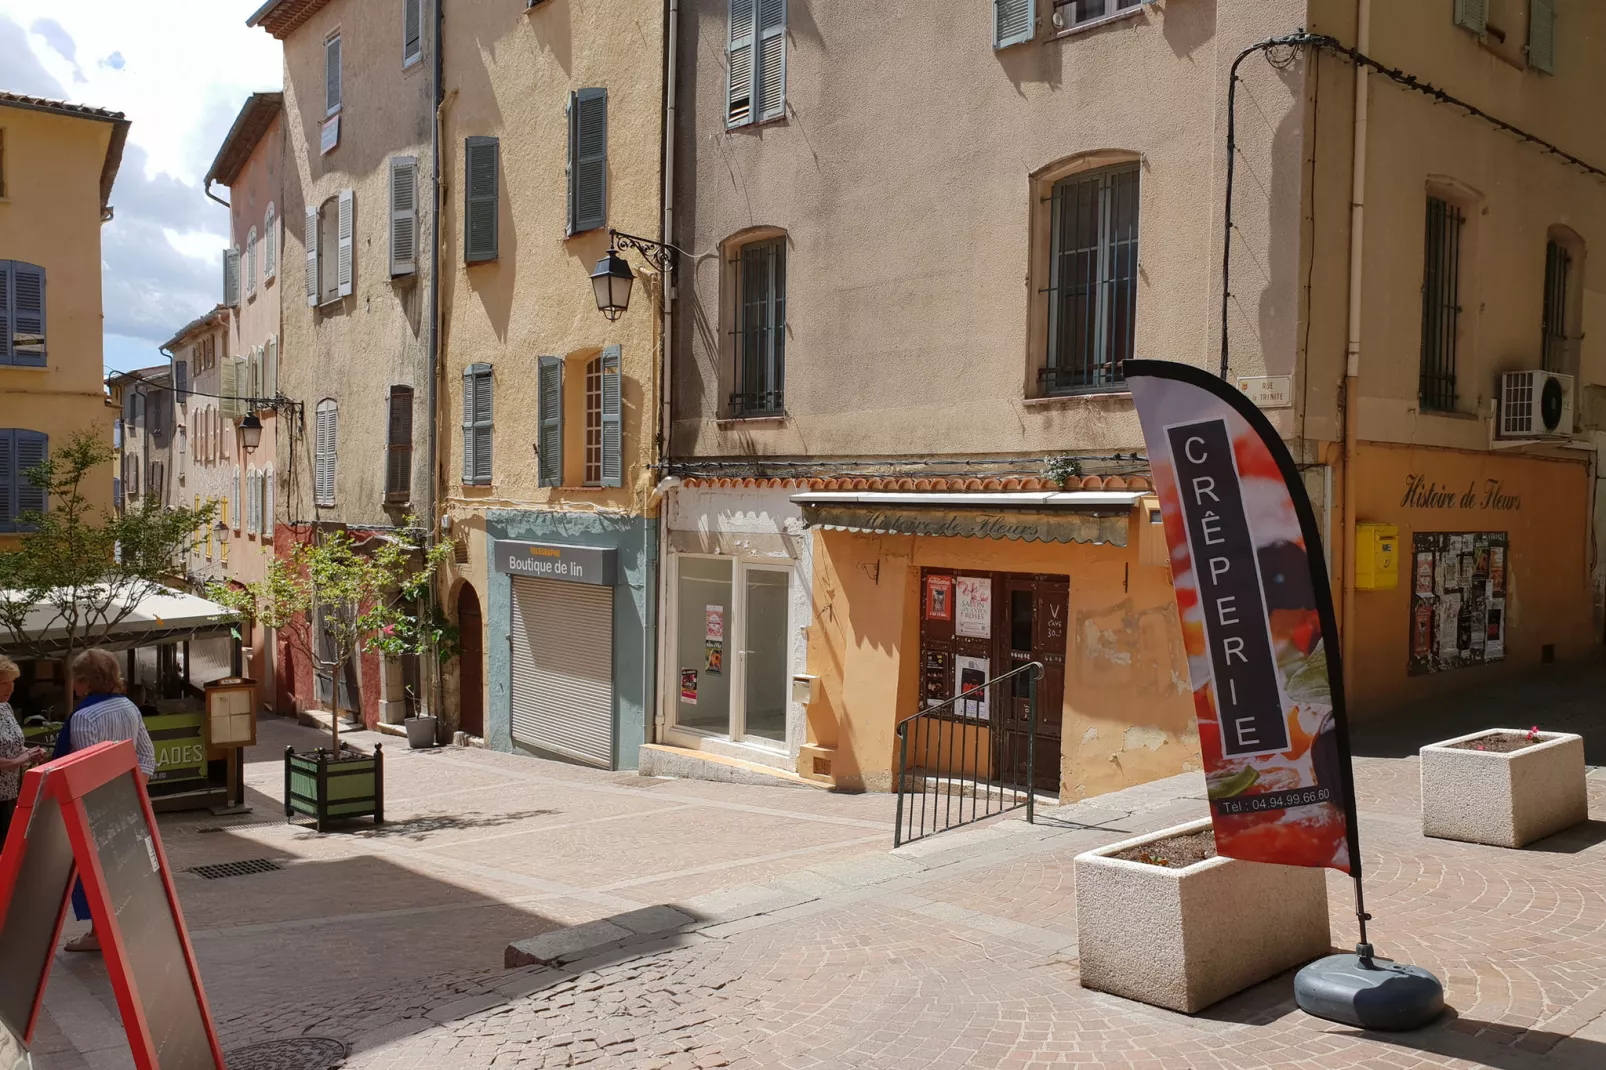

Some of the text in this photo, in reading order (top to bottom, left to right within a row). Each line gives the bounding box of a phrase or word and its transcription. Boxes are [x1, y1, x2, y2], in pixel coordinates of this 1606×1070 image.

[1400, 474, 1520, 511] Histoire de Fleurs
[864, 511, 1039, 536] Hitoire de Fleurs
[509, 556, 583, 577] Boutique de lin
[1184, 436, 1260, 746] CRÊPERIE
[156, 744, 203, 767] ADES
[1223, 802, 1242, 813] Tél
[1252, 788, 1330, 811] 04.94.99.66.60
